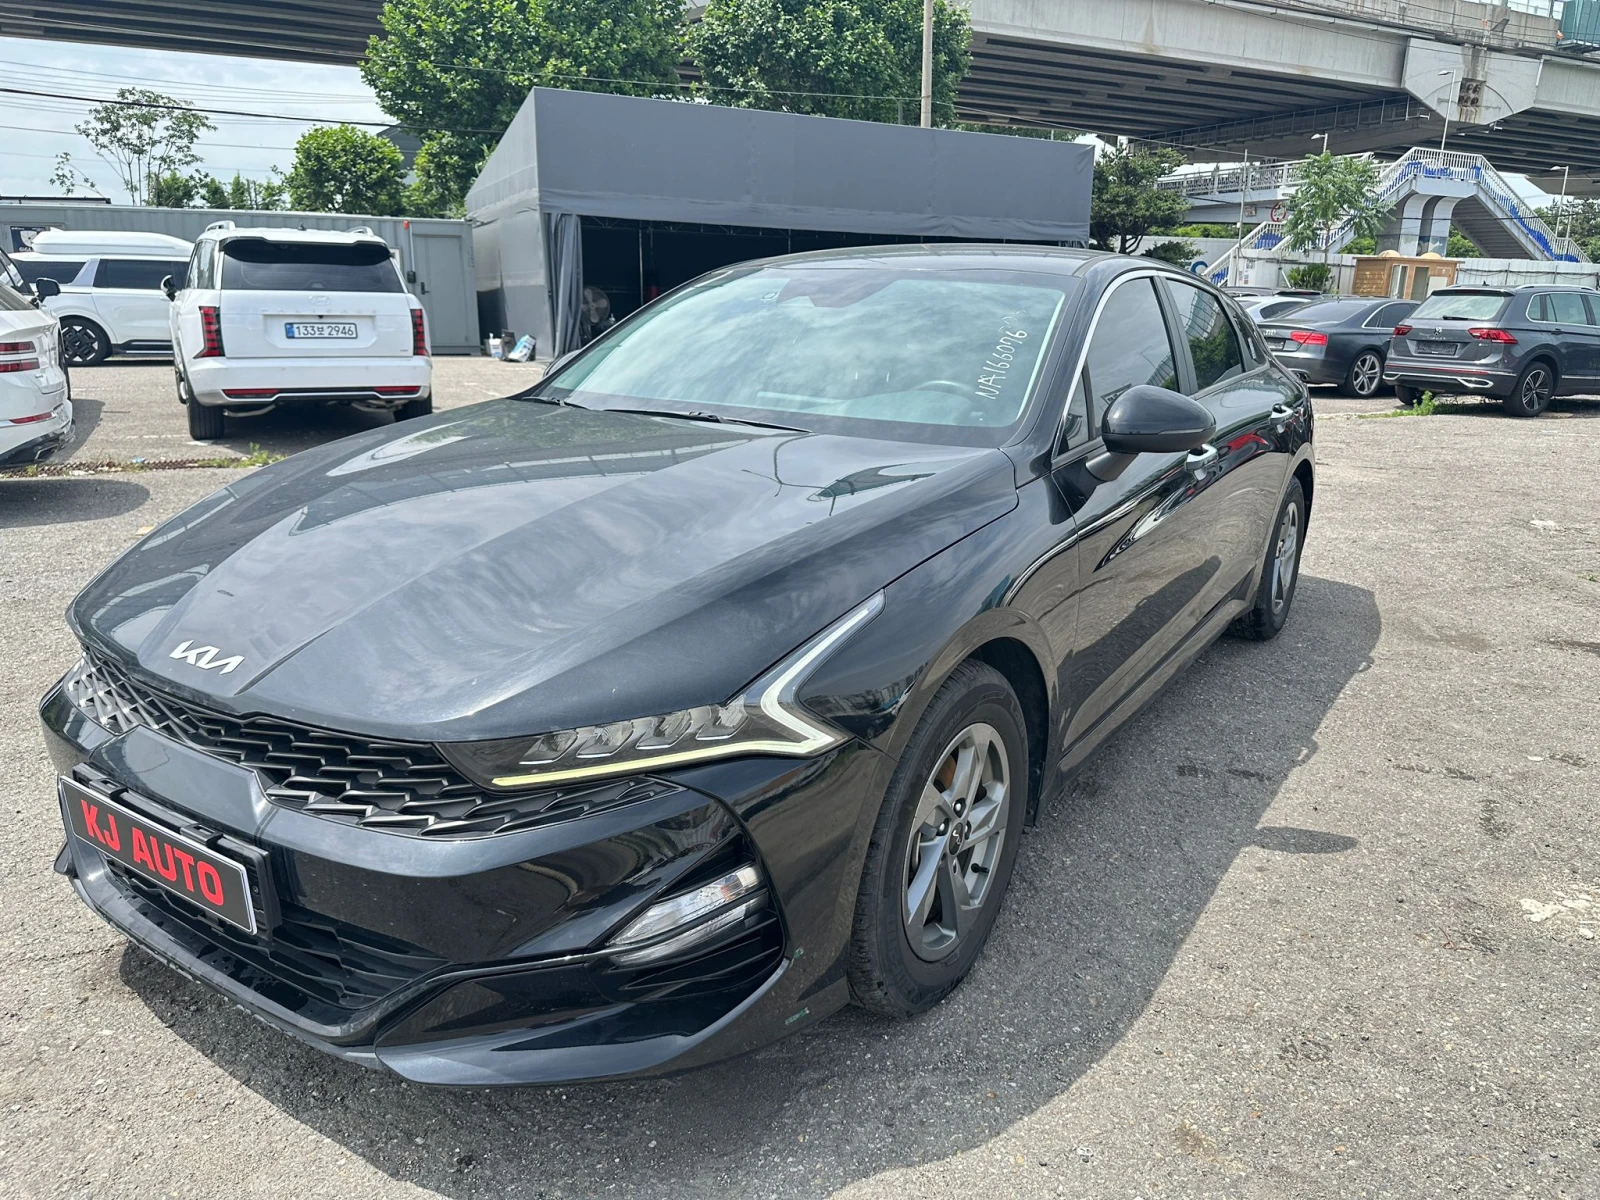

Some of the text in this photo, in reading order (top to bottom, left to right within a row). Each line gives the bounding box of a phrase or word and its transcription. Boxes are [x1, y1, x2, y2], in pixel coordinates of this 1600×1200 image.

[295, 325, 354, 336] 133보 2946
[81, 799, 224, 906] KJ AUTO
